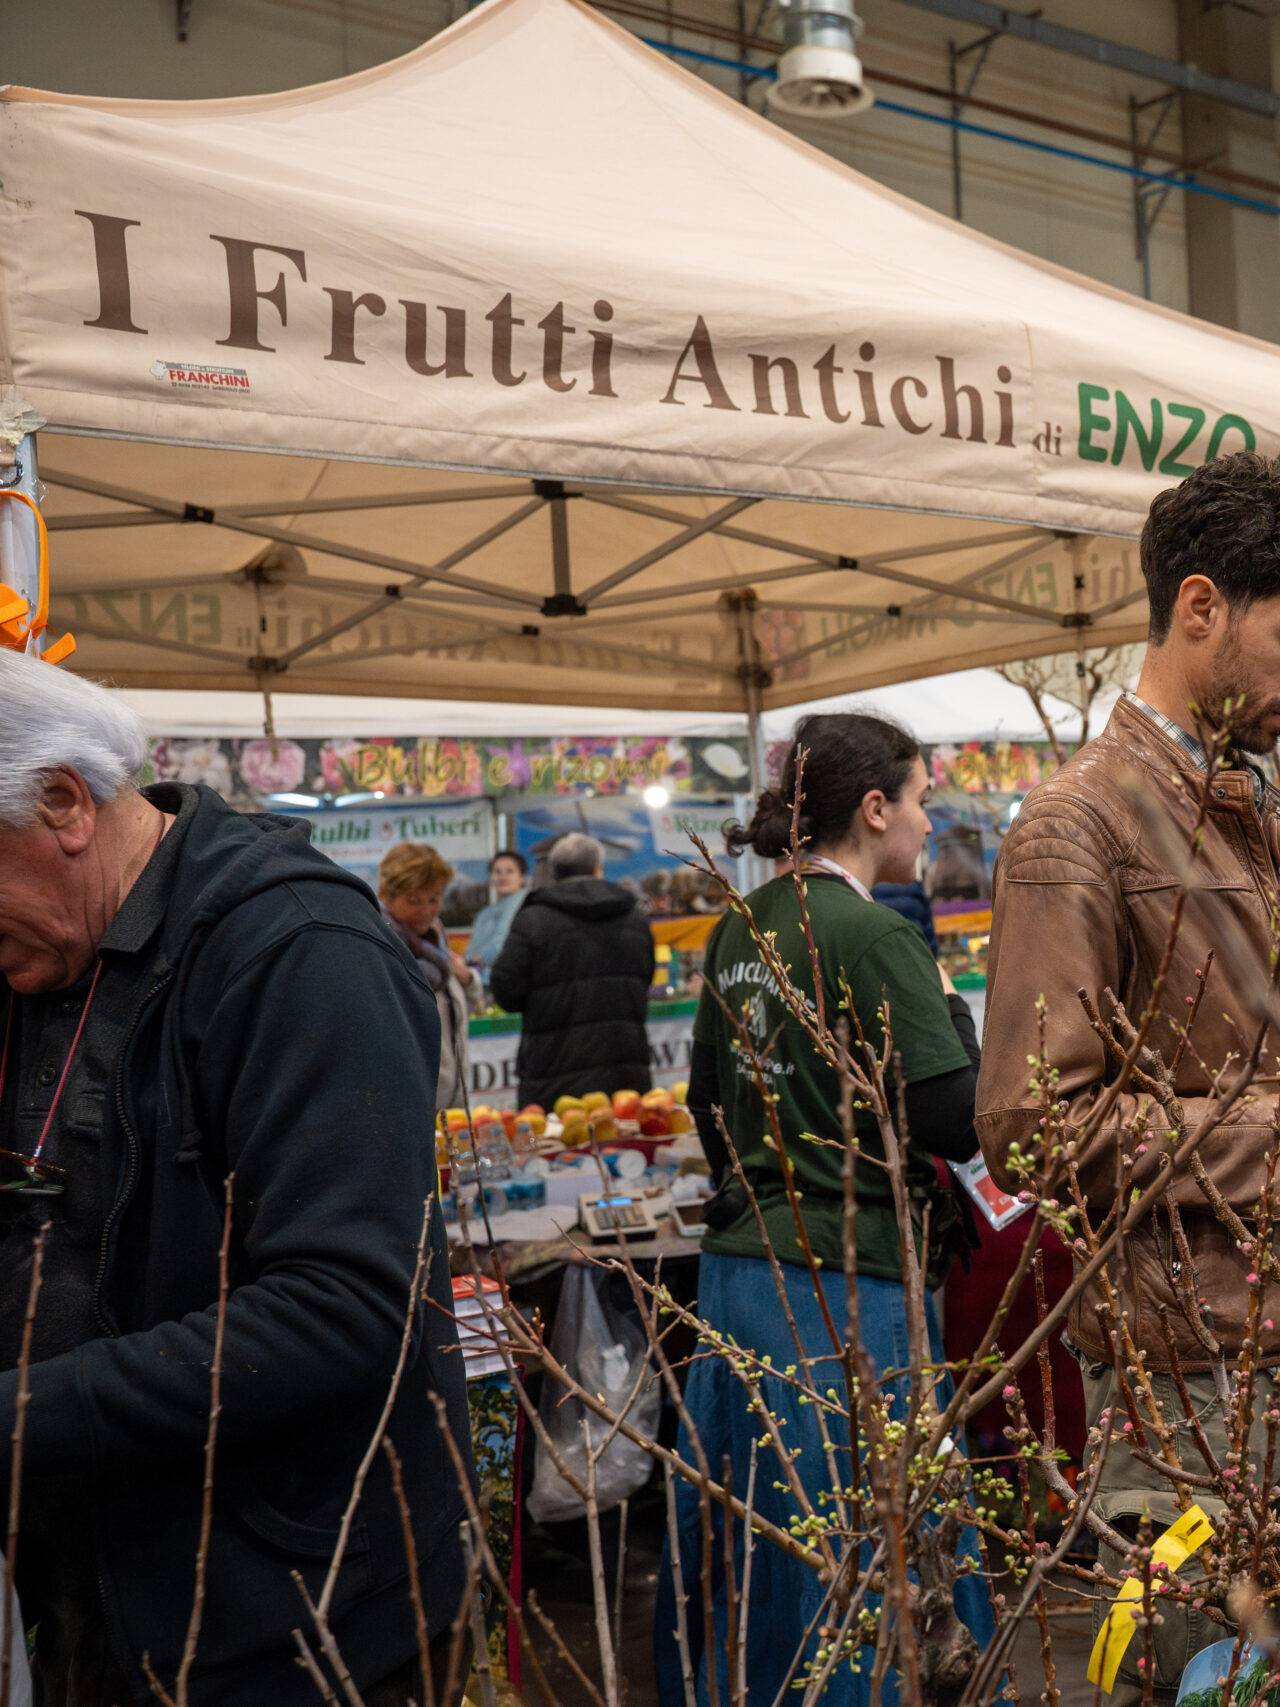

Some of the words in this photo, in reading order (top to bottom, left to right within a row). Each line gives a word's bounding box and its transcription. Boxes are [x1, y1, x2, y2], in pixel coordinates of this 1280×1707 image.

[74, 210, 148, 334] I
[209, 234, 619, 398] Frutti
[659, 314, 1016, 448] Antichi
[1033, 421, 1062, 456] di
[168, 369, 250, 388] FRANCHINI
[353, 738, 472, 787] Bulbi
